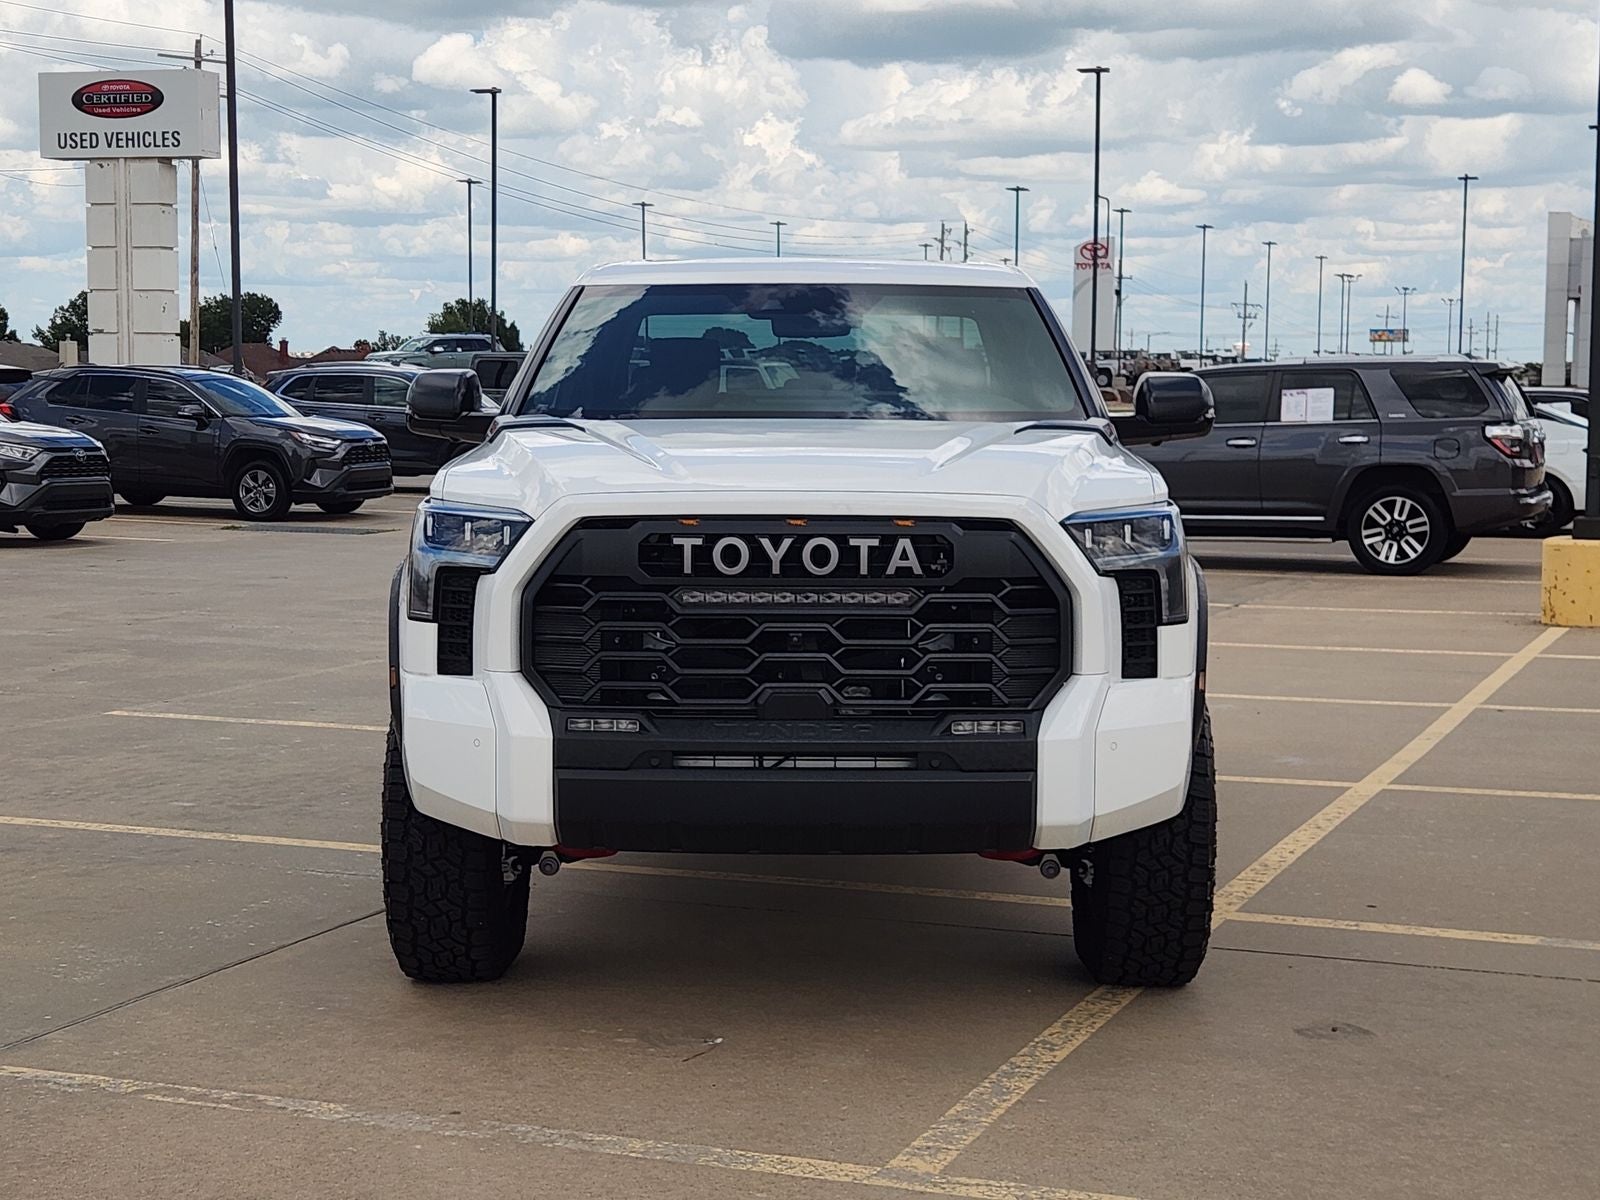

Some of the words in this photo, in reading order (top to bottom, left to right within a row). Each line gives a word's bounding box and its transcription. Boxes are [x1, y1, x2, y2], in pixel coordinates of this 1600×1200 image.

[82, 92, 152, 104] CERTIFIED
[57, 132, 99, 149] USED
[104, 130, 181, 149] VEHICLES
[672, 536, 924, 576] TOYOTA
